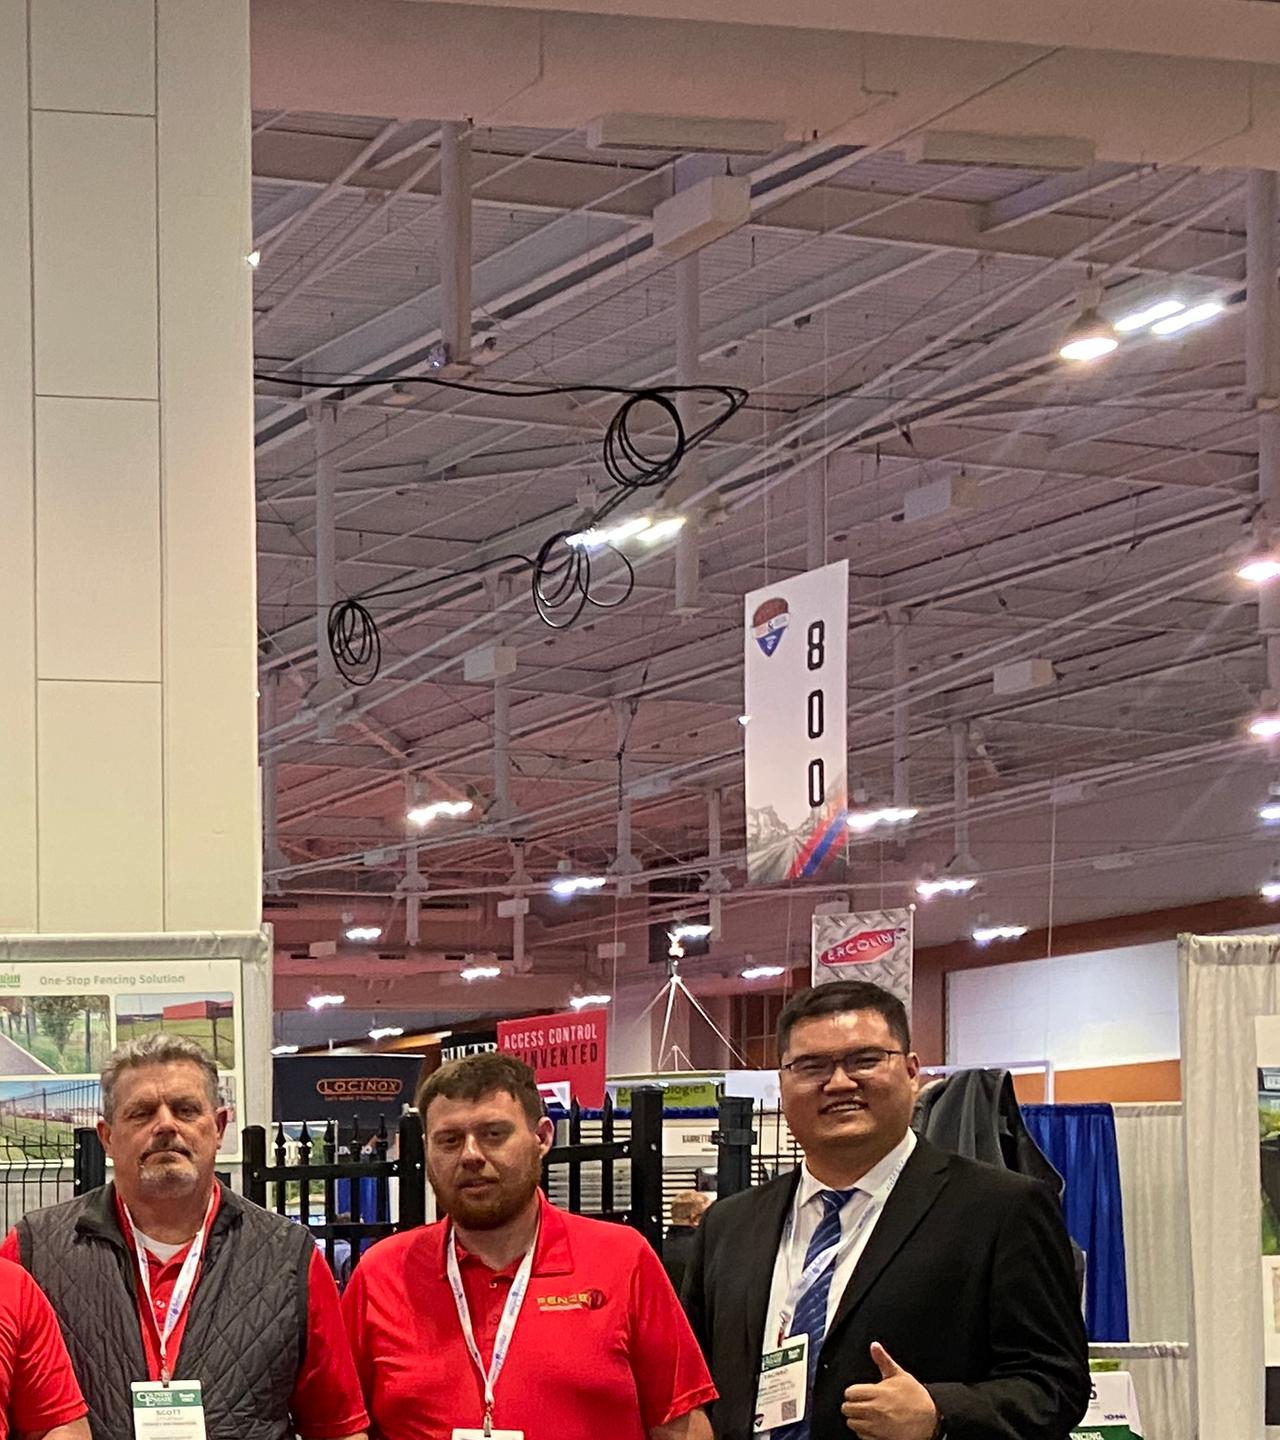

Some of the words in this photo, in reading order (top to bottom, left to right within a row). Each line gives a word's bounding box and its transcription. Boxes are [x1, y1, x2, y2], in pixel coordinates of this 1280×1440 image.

[806, 619, 826, 809] 800
[827, 932, 896, 960] ERCOLIN
[40, 975, 90, 987] One-Stop
[94, 974, 136, 987] Fencing
[139, 973, 185, 985] Solution
[504, 1030, 544, 1049] ACCESS
[549, 1023, 598, 1044] CONTROL
[515, 1042, 598, 1068] INVENTED
[324, 1080, 397, 1094] LOCINOX
